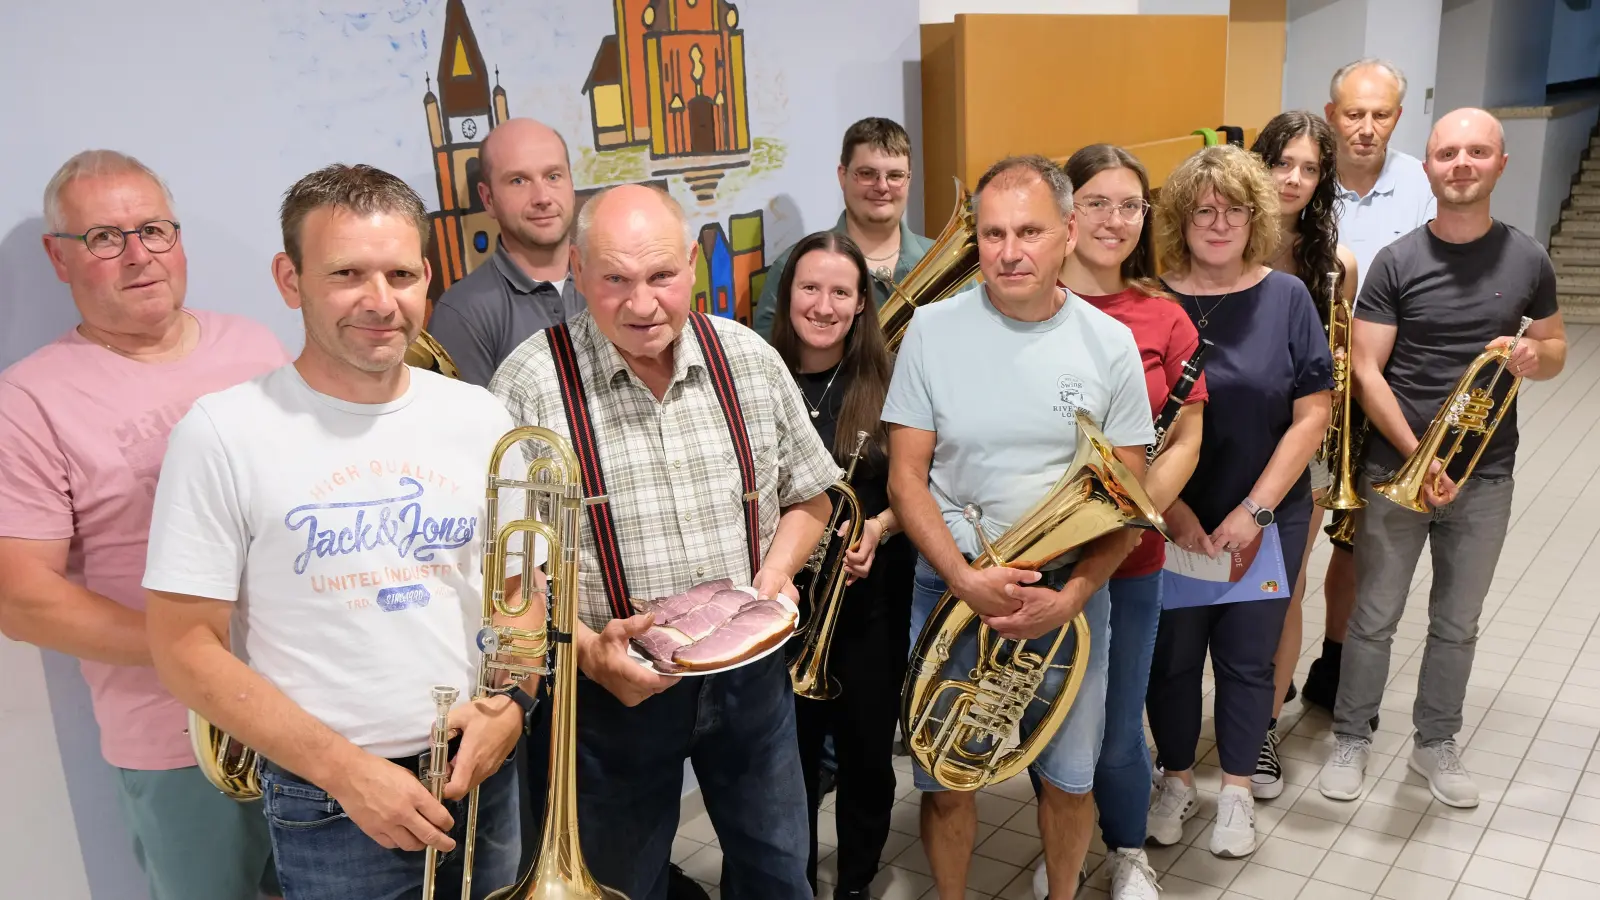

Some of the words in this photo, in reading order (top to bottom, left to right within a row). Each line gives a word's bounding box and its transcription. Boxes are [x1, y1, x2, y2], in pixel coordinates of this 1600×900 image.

[310, 464, 360, 500] HIGH
[369, 459, 461, 495] QUALITY
[311, 571, 381, 594] UNITED
